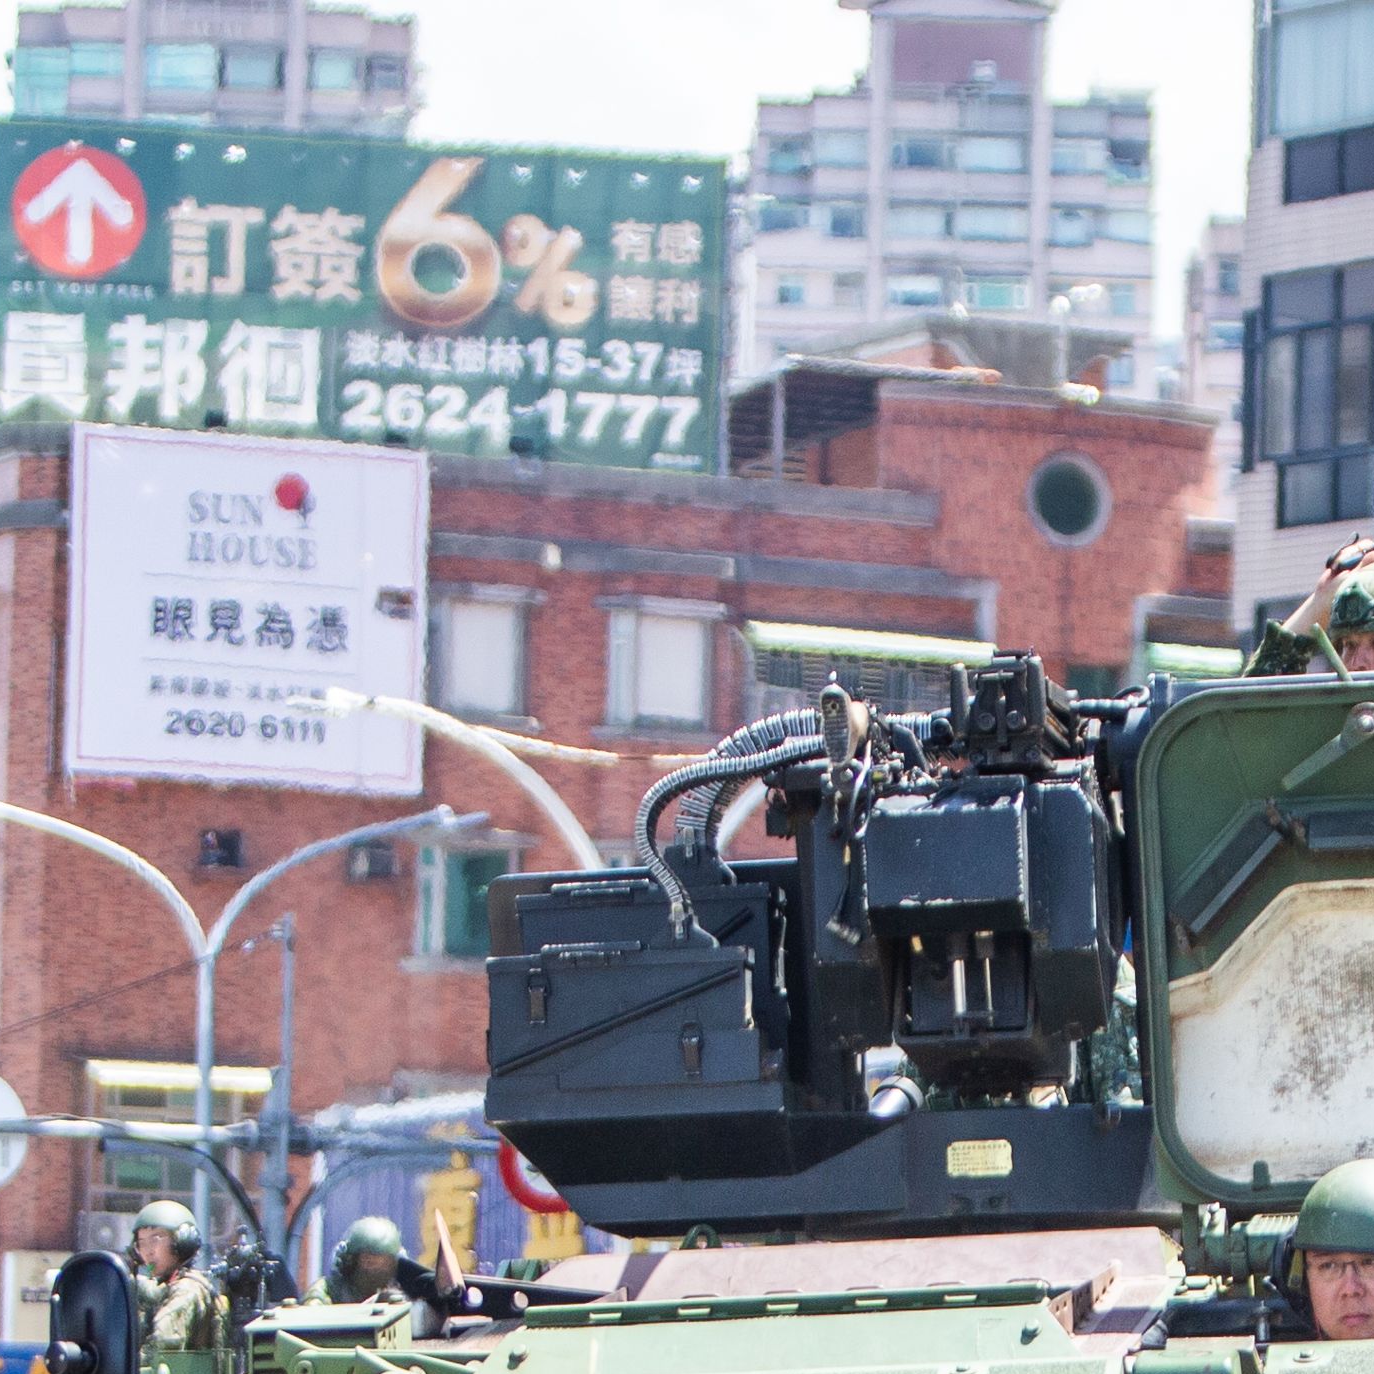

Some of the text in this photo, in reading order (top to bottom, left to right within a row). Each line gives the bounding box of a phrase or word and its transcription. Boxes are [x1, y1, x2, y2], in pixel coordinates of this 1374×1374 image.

[168, 155, 599, 330] 訂簽 6%
[611, 217, 703, 264] 有感
[339, 378, 702, 449] 2624-1777
[187, 489, 264, 528] SUN
[187, 531, 319, 571] HOUSE
